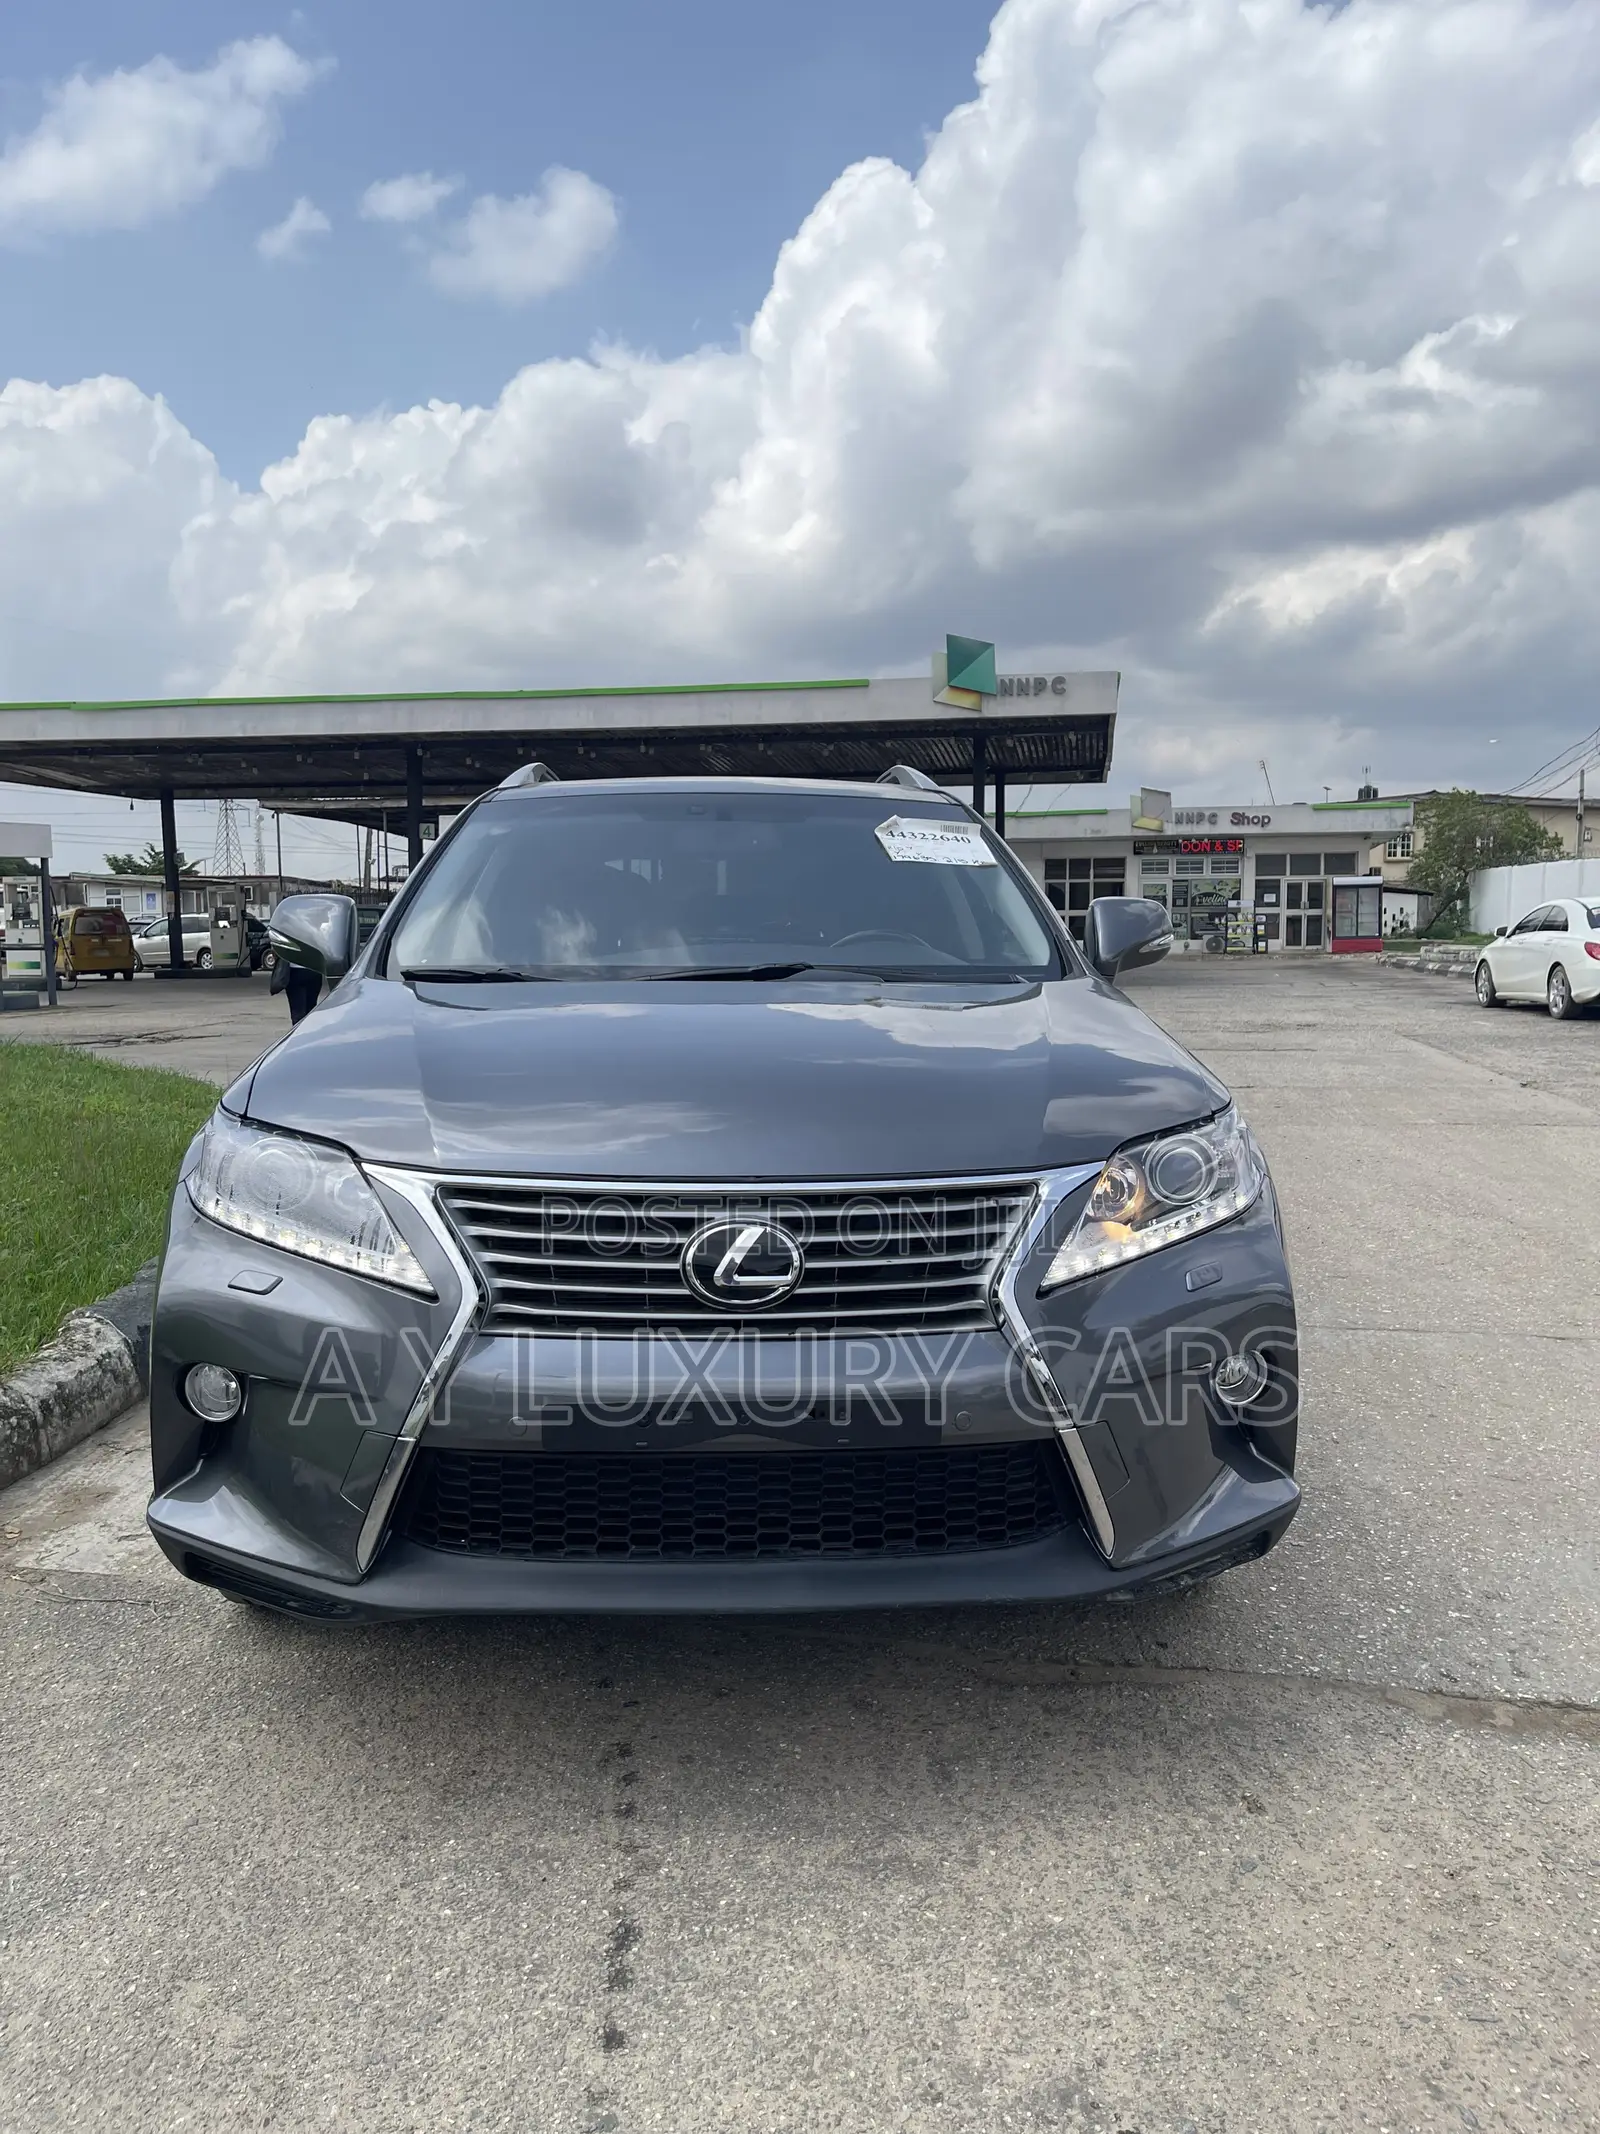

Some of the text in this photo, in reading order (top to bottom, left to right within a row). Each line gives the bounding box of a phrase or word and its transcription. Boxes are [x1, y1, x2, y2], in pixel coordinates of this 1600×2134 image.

[1000, 676, 1067, 696] NNPC
[1174, 811, 1272, 827] NNPC Shop
[422, 825, 432, 837] 4
[885, 830, 972, 844] 44322640
